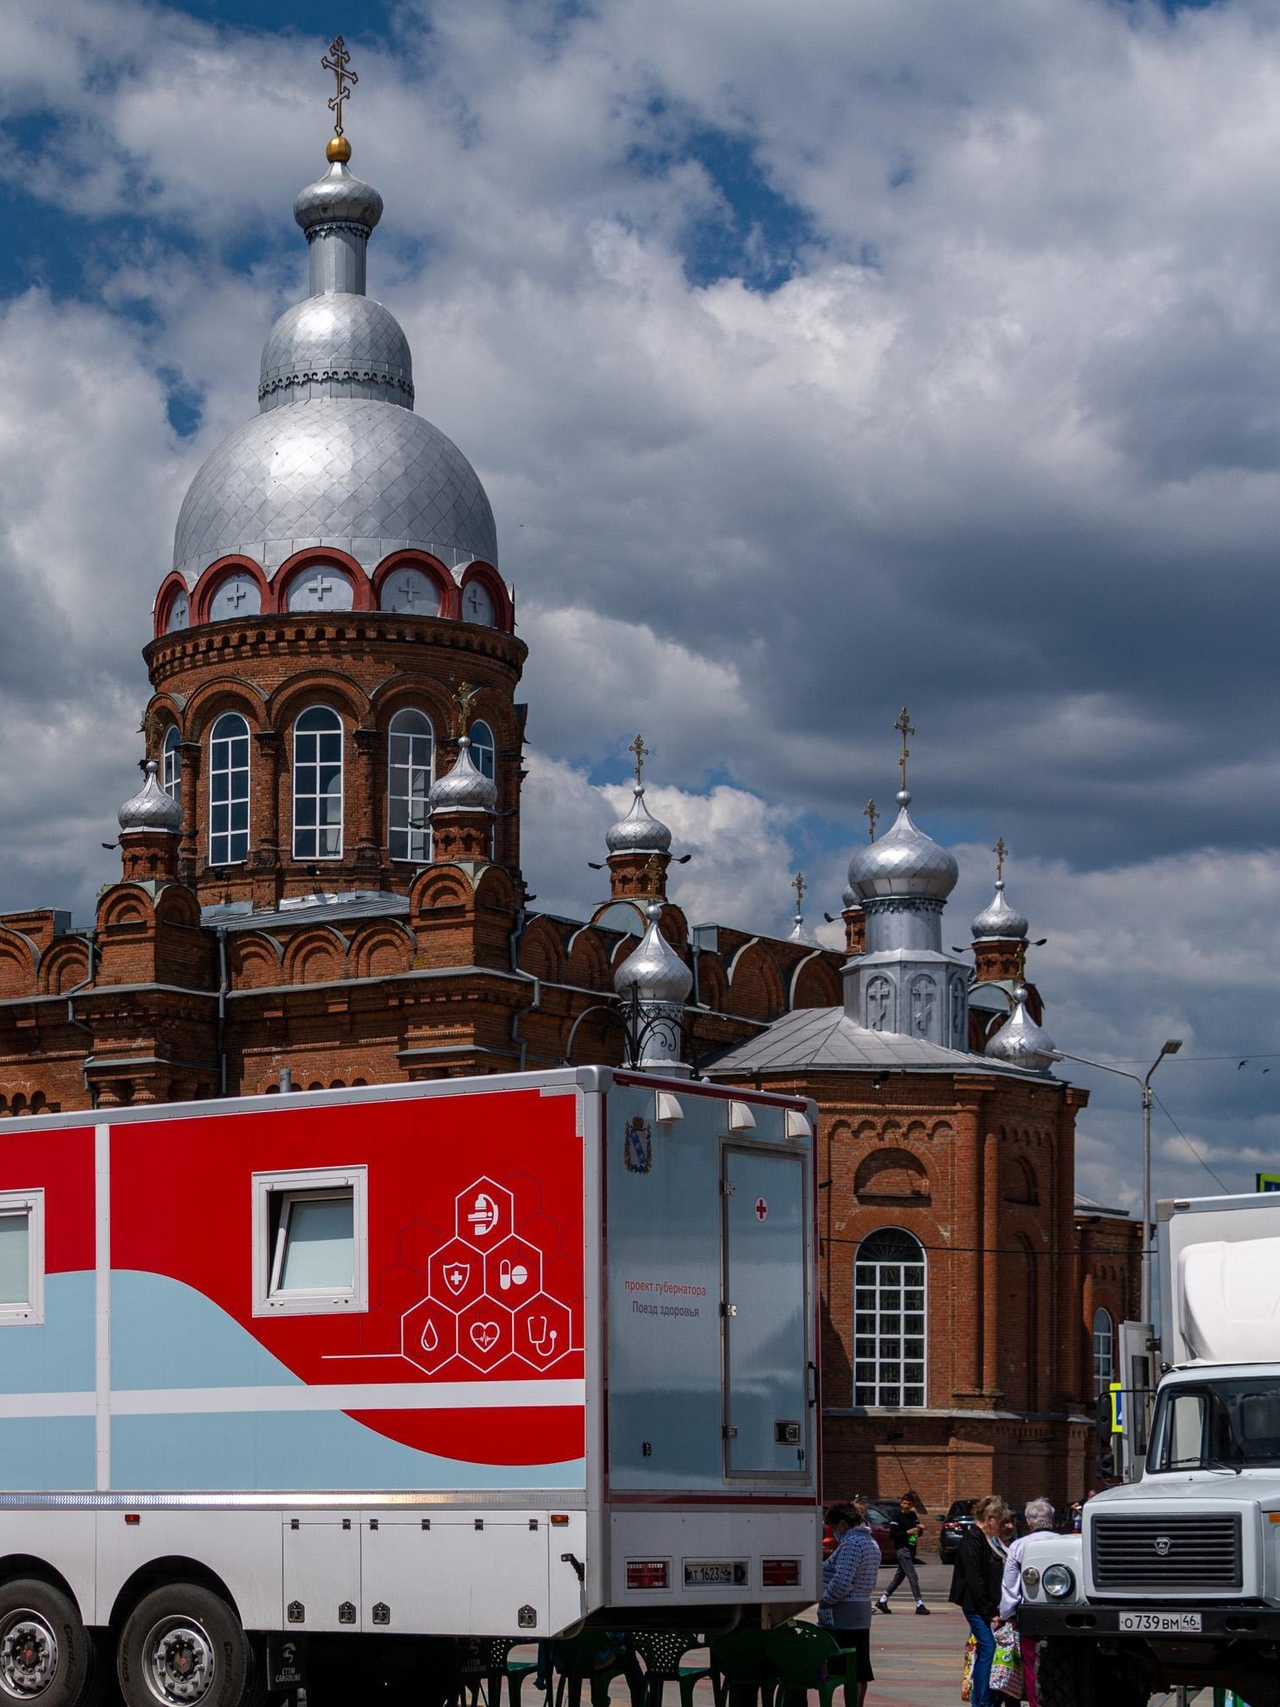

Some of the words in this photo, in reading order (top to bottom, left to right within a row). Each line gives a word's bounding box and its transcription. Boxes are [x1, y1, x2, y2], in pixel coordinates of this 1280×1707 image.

[625, 1281, 653, 1293] проект
[655, 1281, 706, 1297] губернатора
[632, 1301, 658, 1316] Поезд
[659, 1305, 699, 1318] здоровья
[1182, 1615, 1197, 1626] 46
